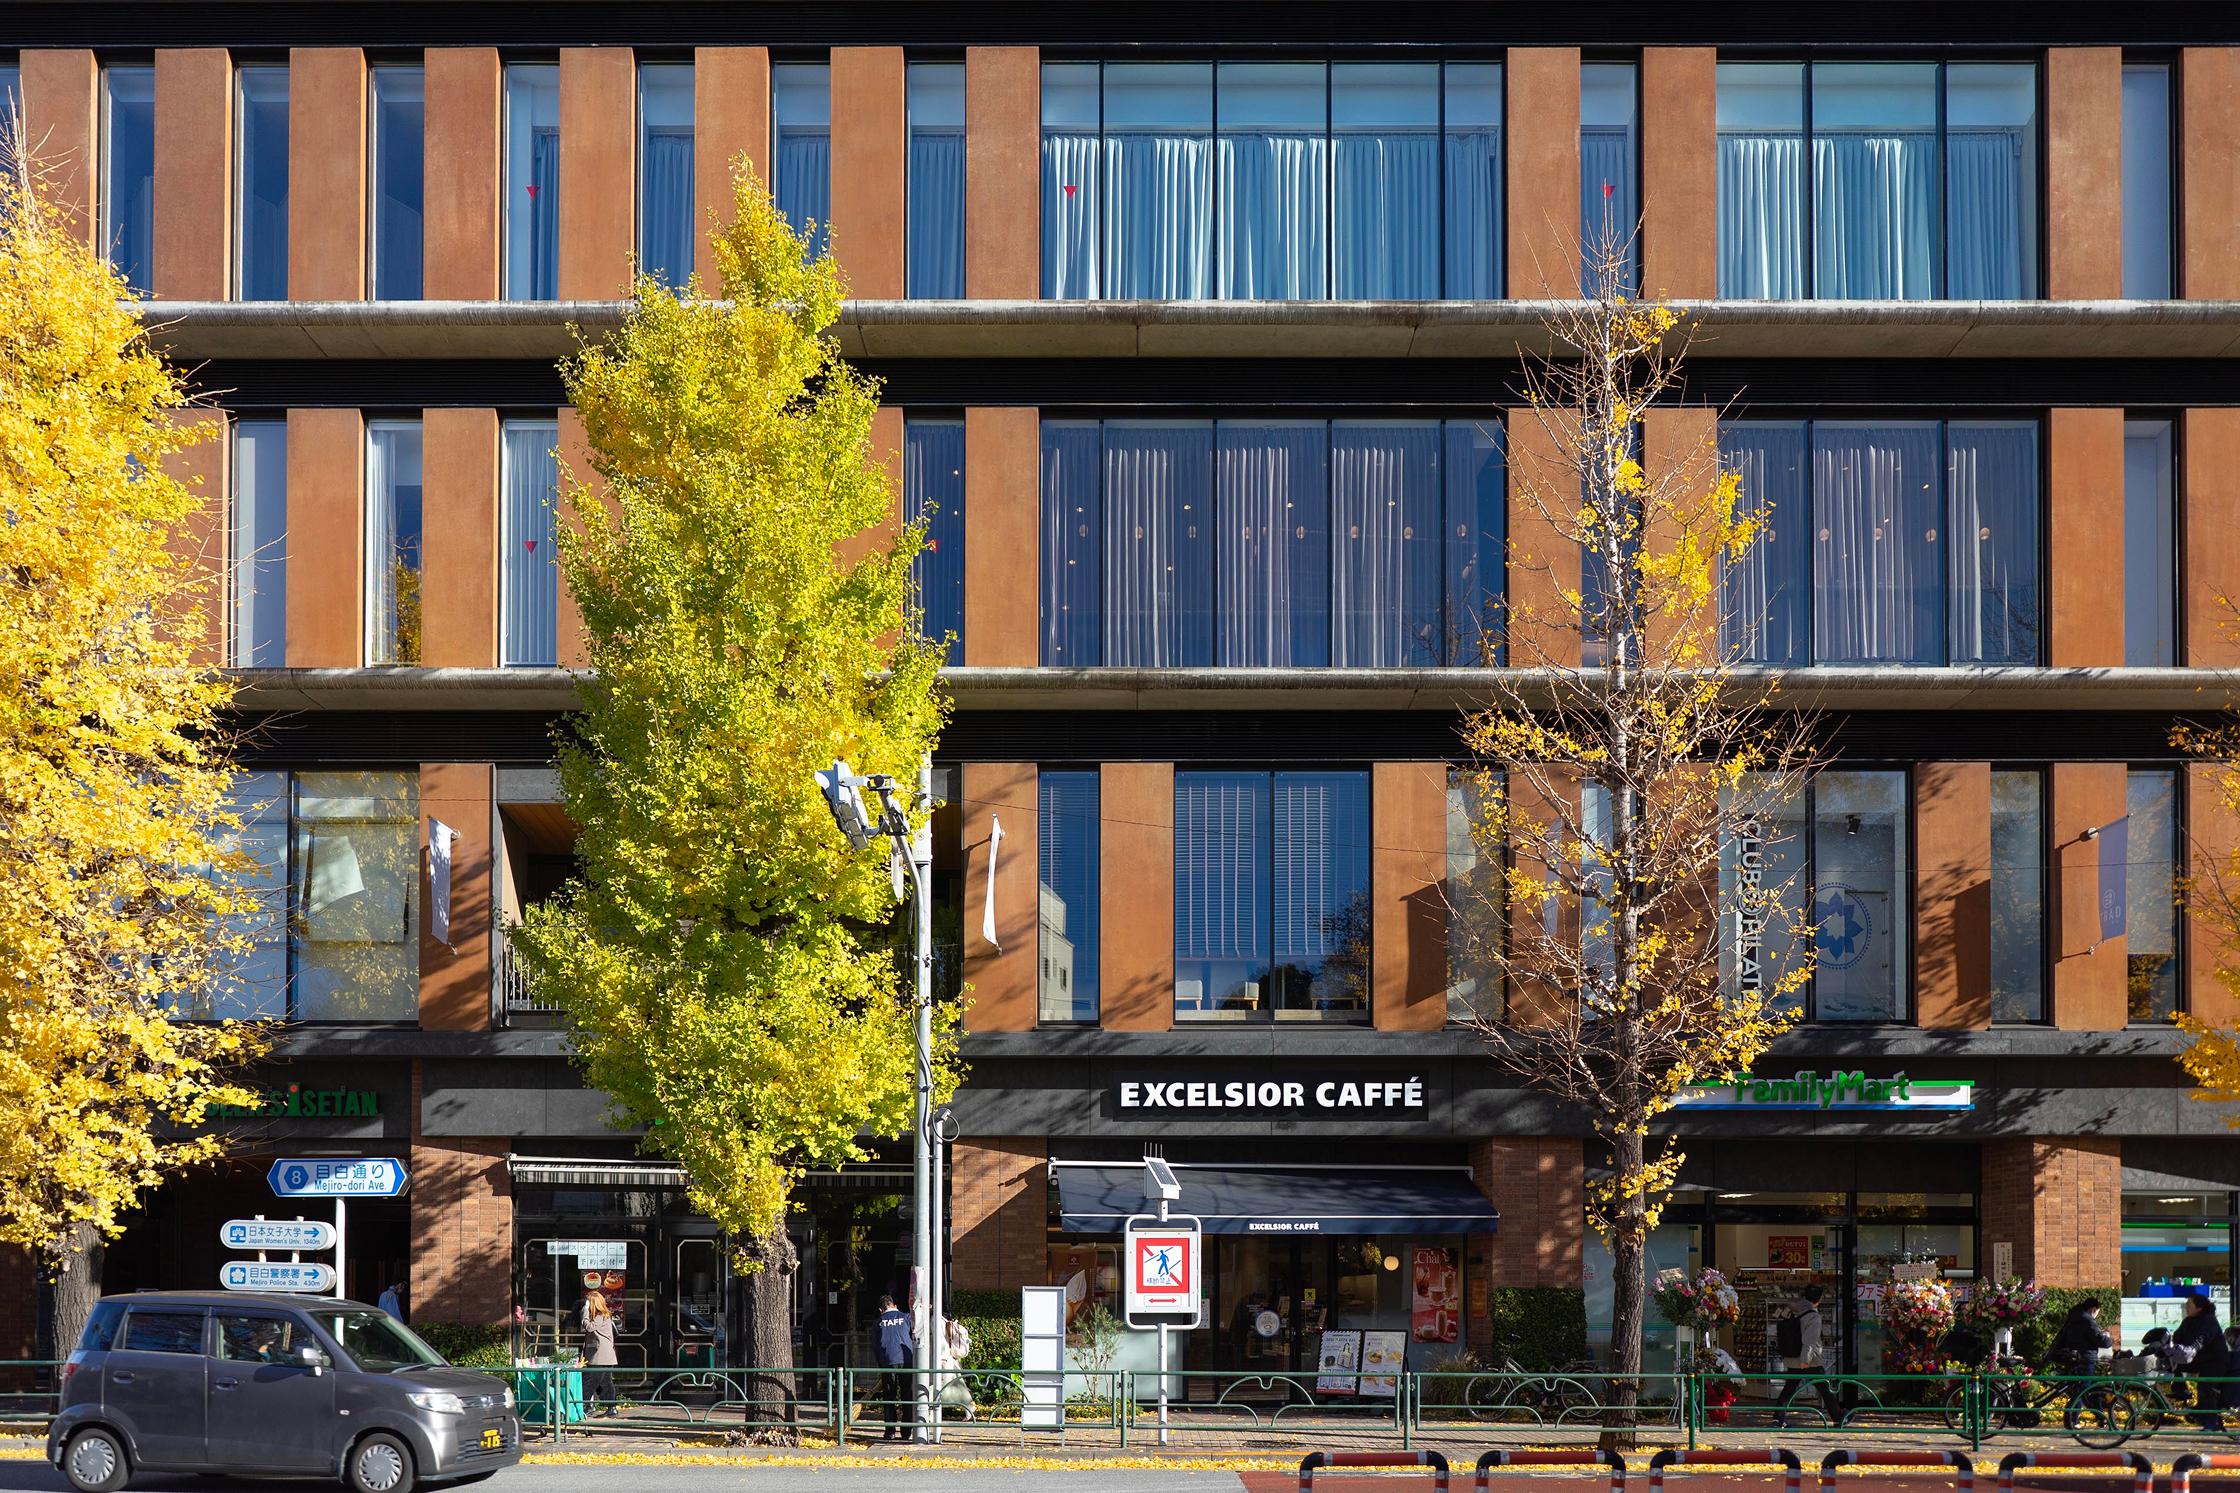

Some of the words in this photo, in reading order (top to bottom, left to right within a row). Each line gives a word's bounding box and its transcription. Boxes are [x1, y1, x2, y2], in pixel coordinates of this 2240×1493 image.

[1742, 819, 1762, 884] CLUB
[1742, 919, 1762, 1017] PILATE
[1120, 1081, 1305, 1108] EXCELSIOR
[1315, 1076, 1423, 1108] CAFFÉ
[1735, 1071, 1910, 1109] FamilyMart
[291, 1170, 302, 1185] 8
[316, 1164, 385, 1180] 目白通り
[314, 1179, 365, 1193] Mejiro-dori
[368, 1180, 387, 1191] Ave.
[249, 1226, 302, 1237] 日本女子大学
[1249, 1222, 1292, 1231] EXCELSIOR
[1293, 1221, 1320, 1230] CAFFÉ
[1416, 1251, 1441, 1264] Chai
[249, 1267, 301, 1279] 目白警察署
[1146, 1277, 1172, 1285] 横断禁止
